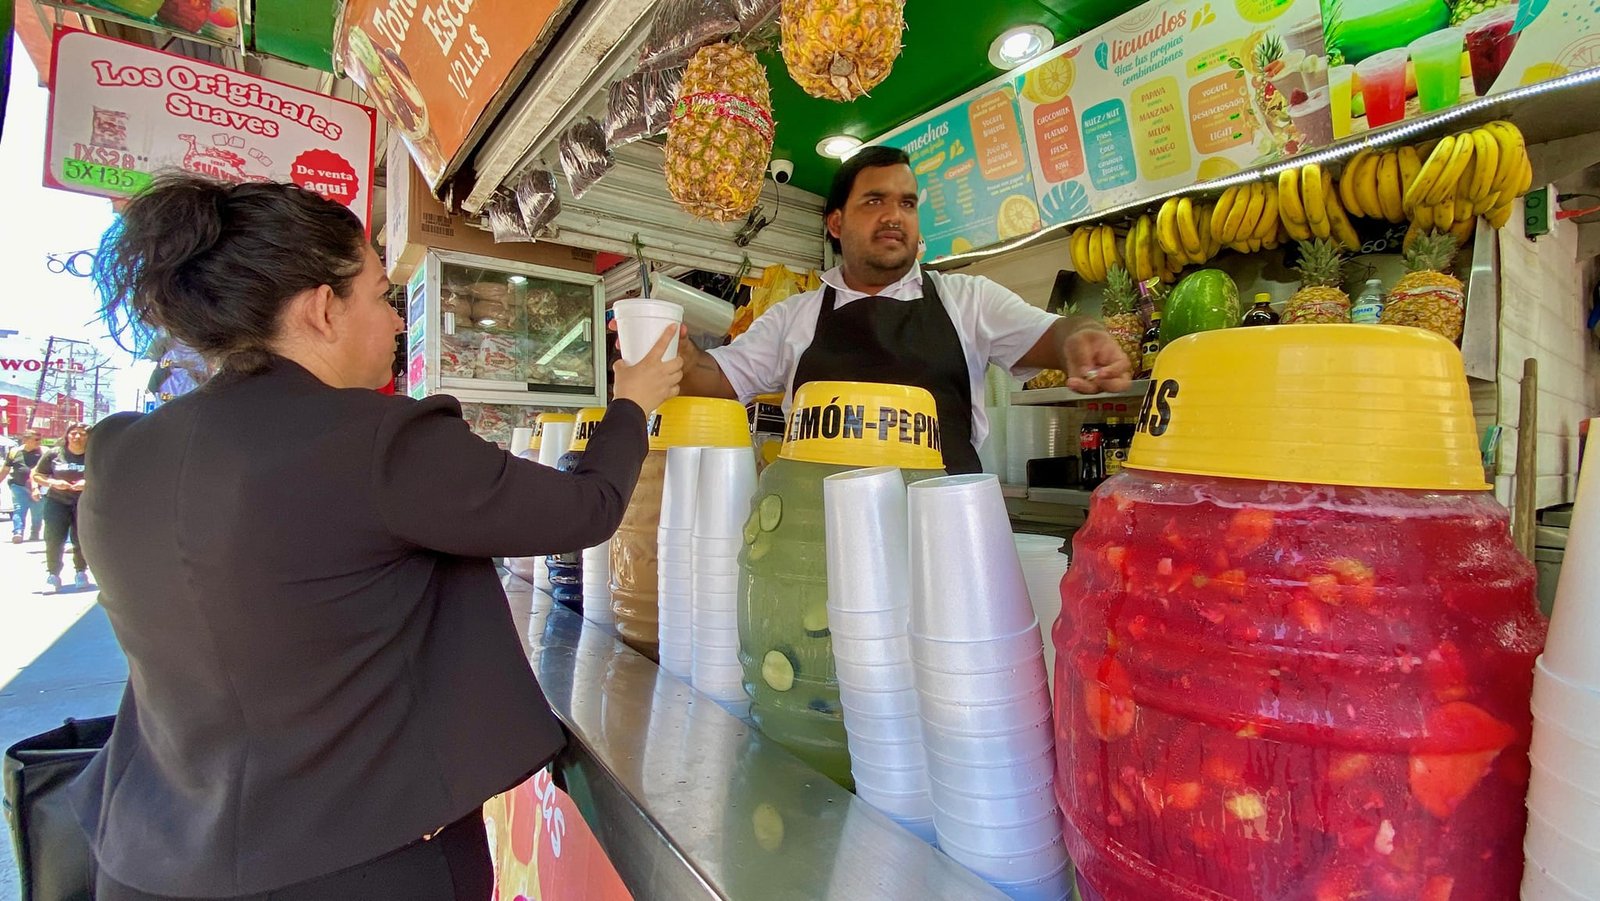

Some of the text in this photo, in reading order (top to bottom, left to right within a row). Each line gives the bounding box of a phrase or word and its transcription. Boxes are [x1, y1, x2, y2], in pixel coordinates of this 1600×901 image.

[1112, 10, 1187, 64] licuados
[1114, 62, 1133, 77] Haz
[1135, 54, 1148, 67] tus
[1150, 35, 1184, 62] propias
[1122, 48, 1184, 86] combinaciones
[92, 60, 342, 141] Los Originales
[166, 92, 279, 137] Suaves
[1139, 104, 1175, 122] MANZANA
[297, 165, 354, 181] De venta
